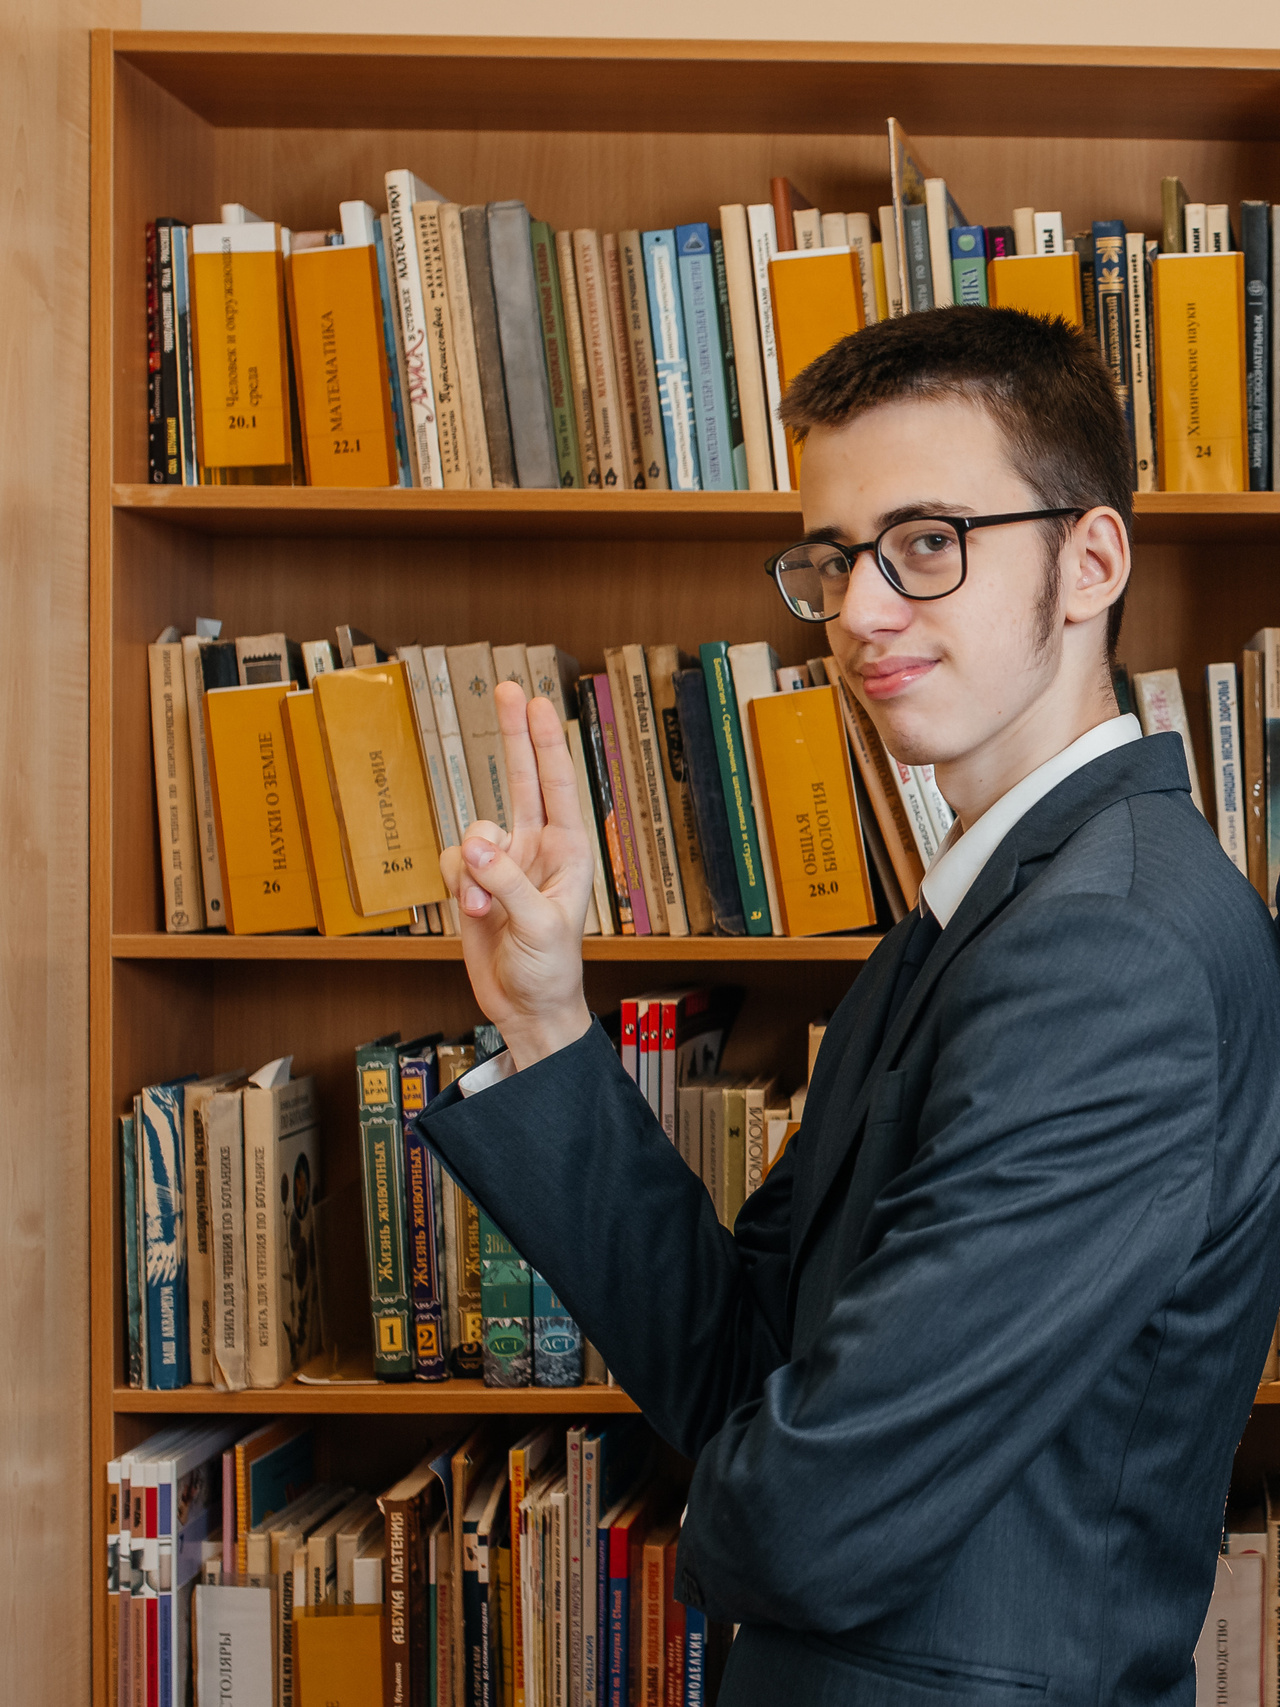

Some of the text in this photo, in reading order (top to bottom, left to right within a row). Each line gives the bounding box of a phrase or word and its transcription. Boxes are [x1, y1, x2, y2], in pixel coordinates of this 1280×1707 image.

[386, 185, 409, 280] МАТЕМАТИКИ
[221, 236, 239, 407] Человек и окружающая
[247, 366, 262, 407] среда
[320, 310, 343, 432] МАТЕМАТИКА
[1187, 302, 1201, 436] Химические науки
[228, 416, 256, 429] 20.1
[334, 439, 361, 454] 22.1
[1196, 445, 1212, 458] 24
[258, 732, 287, 870] НАУКИ О ЗЕМЛЕ
[368, 750, 400, 851] ГЕОГРАФИЯ
[714, 658, 726, 706] Биология
[723, 714, 739, 773] Справочник
[732, 776, 746, 831] школьника
[743, 842, 756, 886] студента
[796, 812, 817, 876] ОБЩАЯ
[811, 781, 837, 873] БИОЛОГИЯ
[263, 880, 281, 895] 26
[382, 857, 412, 874] 26.8
[809, 881, 838, 897] 28.0
[374, 1140, 394, 1282] Жизнь животных
[409, 1146, 429, 1288] Жизнь животных
[219, 1145, 235, 1349] КНИГА ДЛЯ ЧТЕНИЯ ПО БОТАНИКЕ
[254, 1146, 269, 1347] КНИГА ДЛЯ ЧТЕНИЯ ПО БОТАНИКЕ
[160, 1286, 176, 1364] ВАШ АКВАРИУМ
[386, 1323, 396, 1346] 1
[419, 1329, 434, 1350] 2
[493, 1339, 518, 1351] АСТ
[541, 1338, 572, 1351] АСТ
[391, 1511, 404, 1583] ПЛЕТЕНИЯ
[282, 1571, 292, 1621] МАСТЕРИТЬ
[391, 1590, 405, 1644] АЗБУКА
[585, 1635, 594, 1691] БИЖУТЕРИЯ
